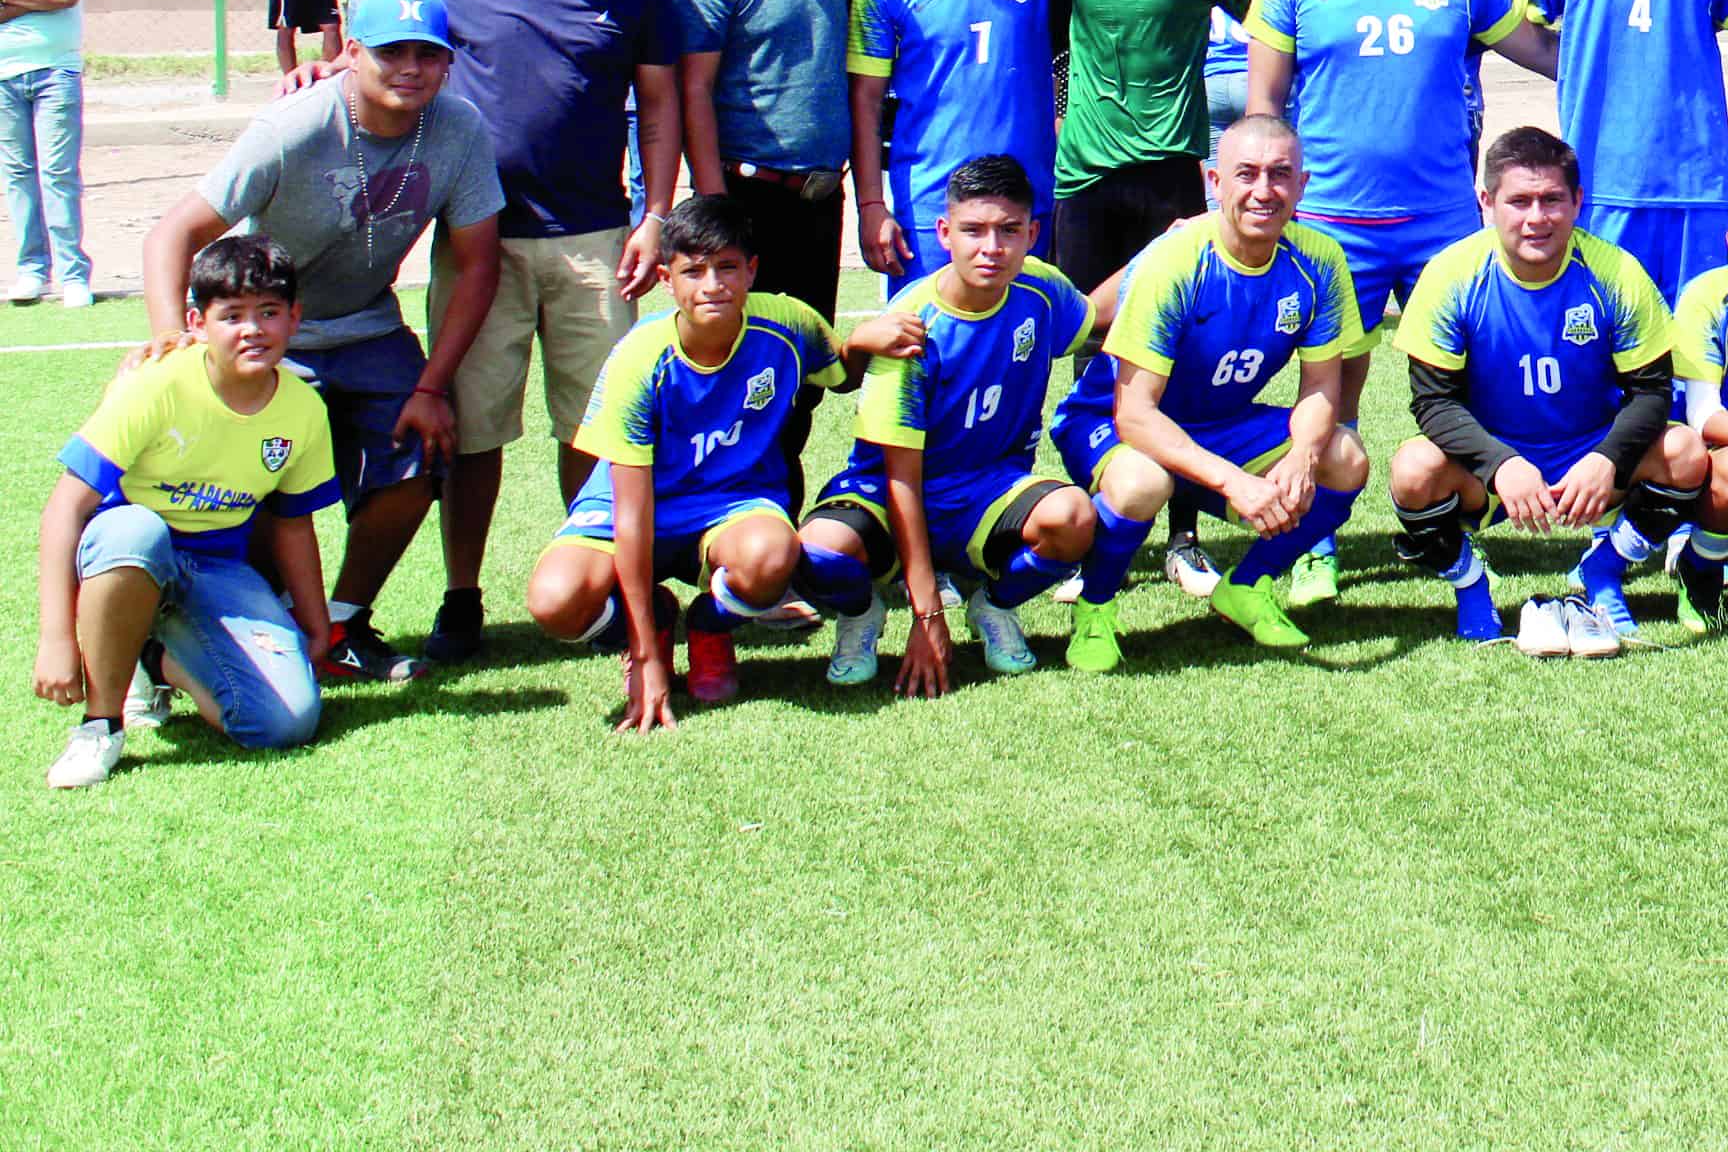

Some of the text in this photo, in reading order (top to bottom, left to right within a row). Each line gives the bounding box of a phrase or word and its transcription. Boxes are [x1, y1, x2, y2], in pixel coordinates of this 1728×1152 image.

[1355, 13, 1415, 57] 26
[1211, 348, 1265, 386] 63
[1518, 353, 1562, 397] 10
[964, 384, 1003, 429] 19
